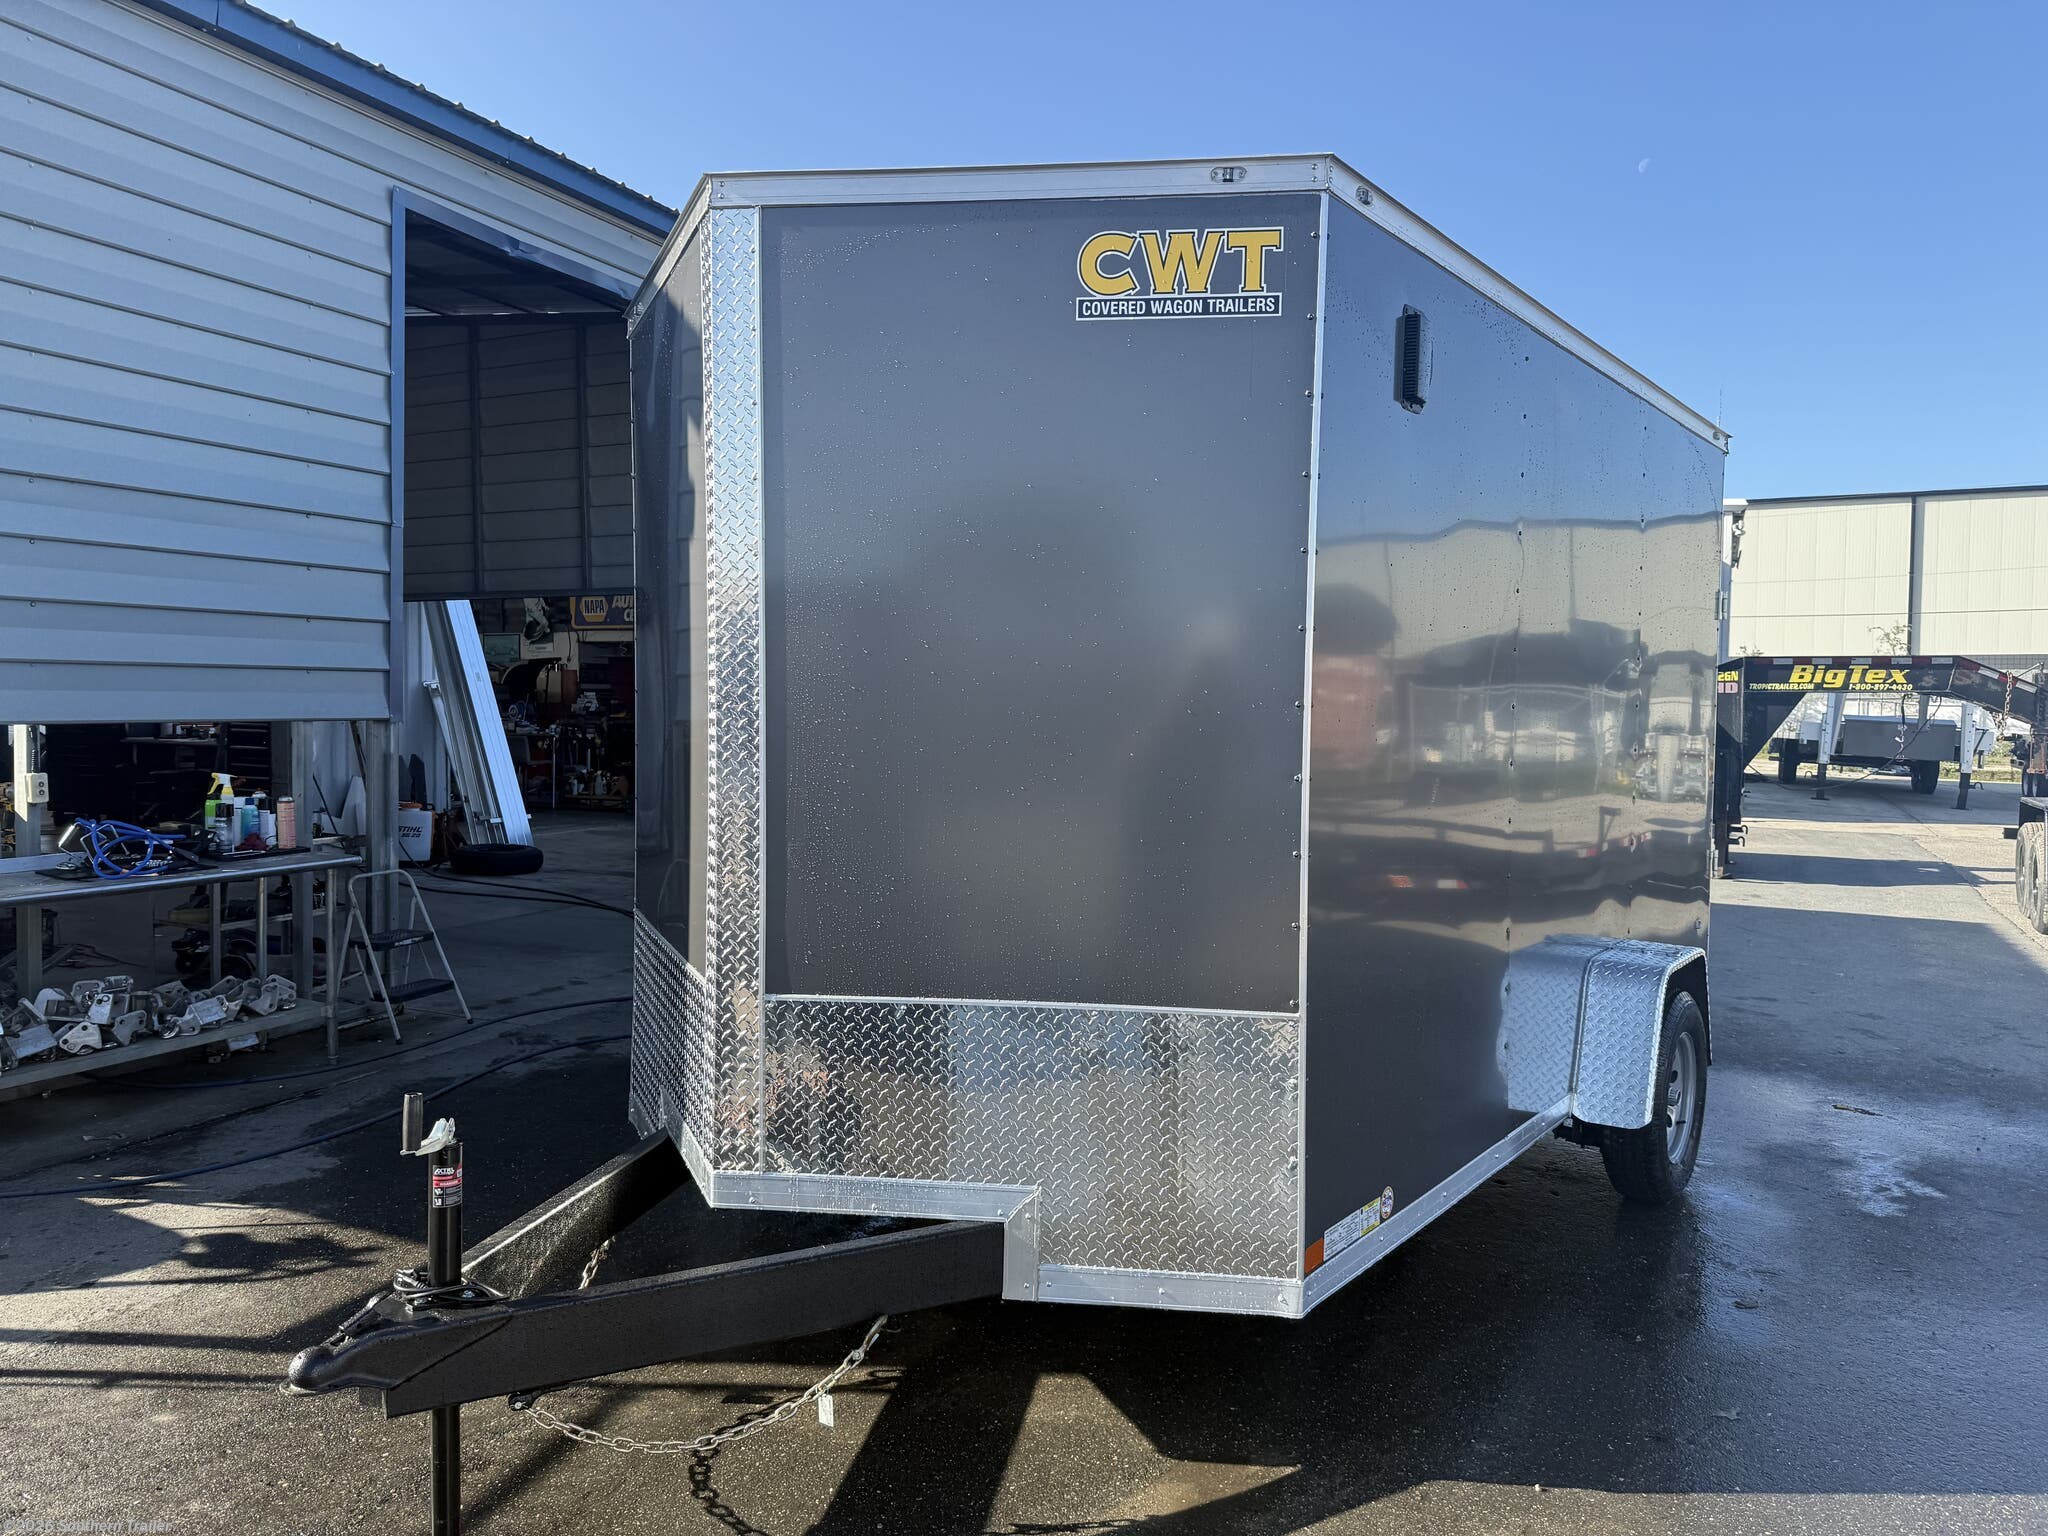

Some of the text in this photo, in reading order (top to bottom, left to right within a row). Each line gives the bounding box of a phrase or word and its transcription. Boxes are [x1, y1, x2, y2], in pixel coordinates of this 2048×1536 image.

[1077, 226, 1284, 296] CWT
[1082, 297, 1275, 316] COVERED WAGON TRAILERS
[584, 599, 605, 614] NAPA
